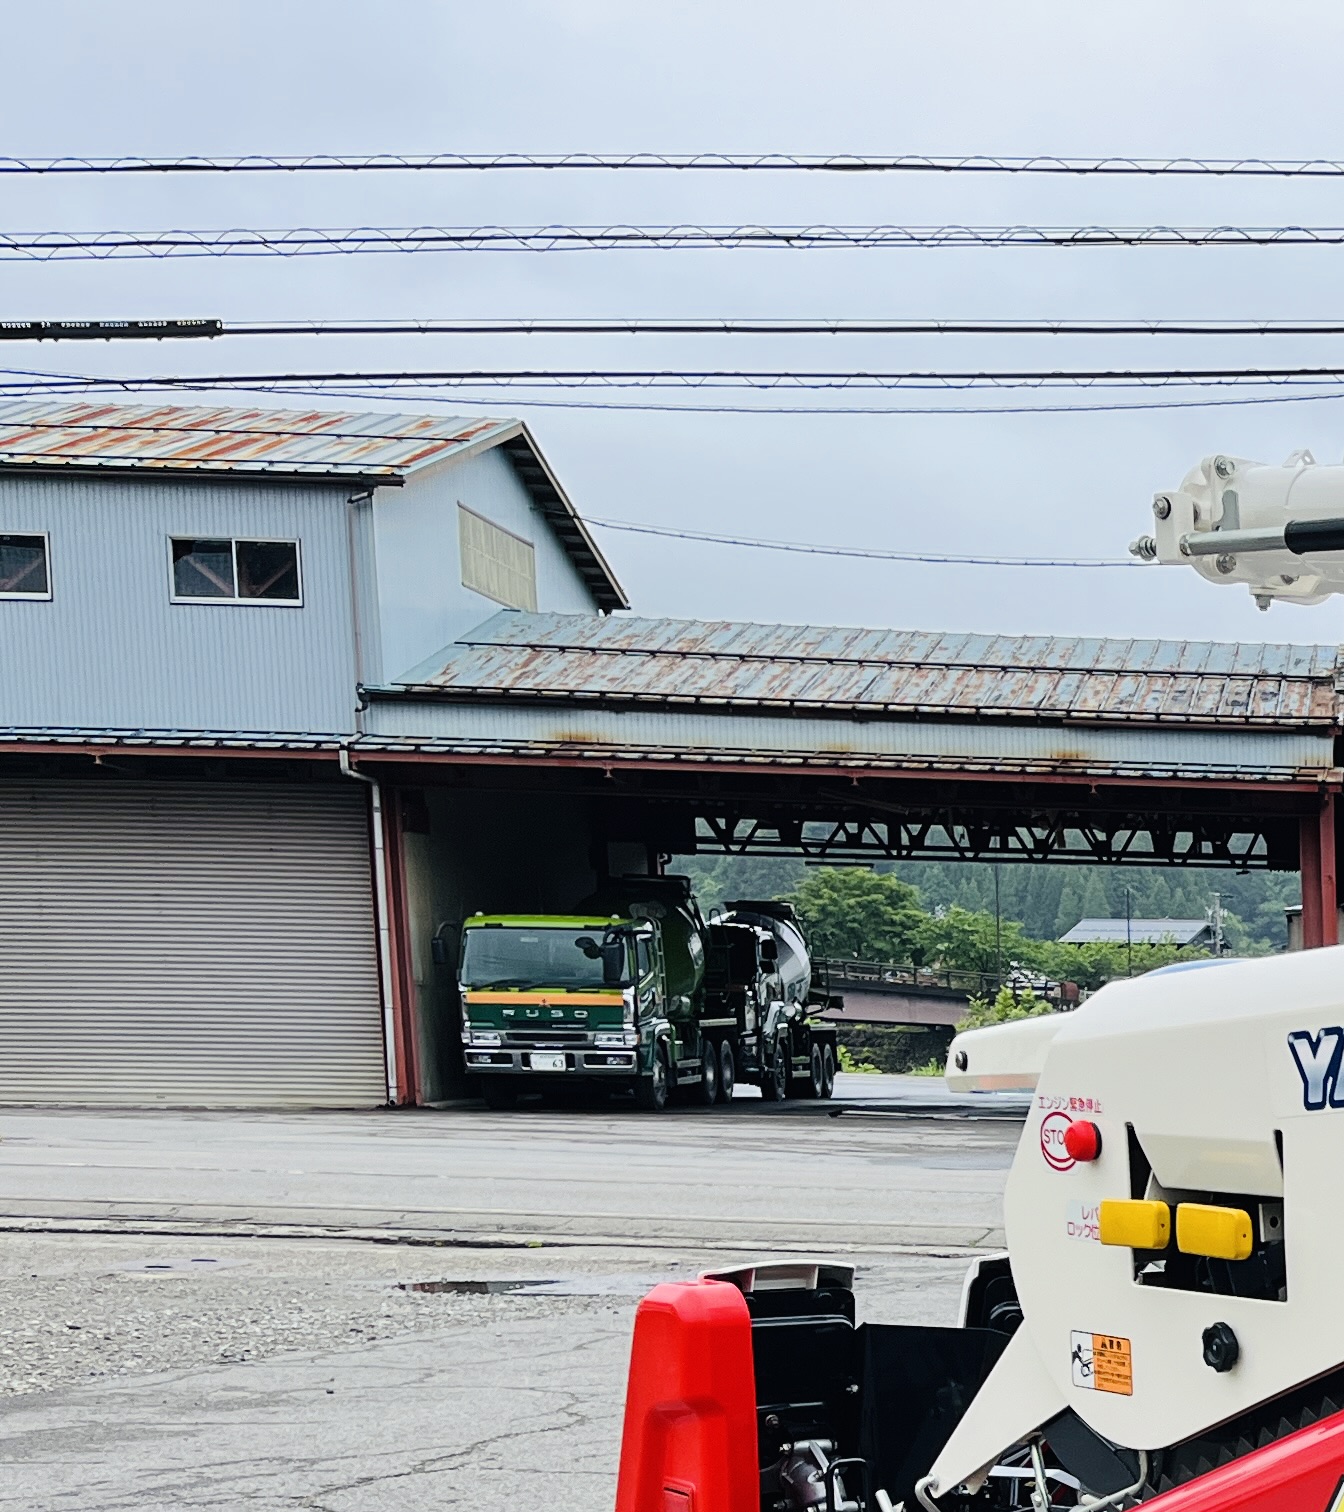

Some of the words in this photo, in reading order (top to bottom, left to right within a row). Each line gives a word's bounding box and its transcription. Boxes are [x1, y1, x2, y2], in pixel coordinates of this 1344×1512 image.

[502, 1009, 588, 1018] FUSO
[1039, 1096, 1102, 1113] エンジン緊急停止
[1043, 1129, 1064, 1146] STO
[1067, 1221, 1101, 1241] ロック位
